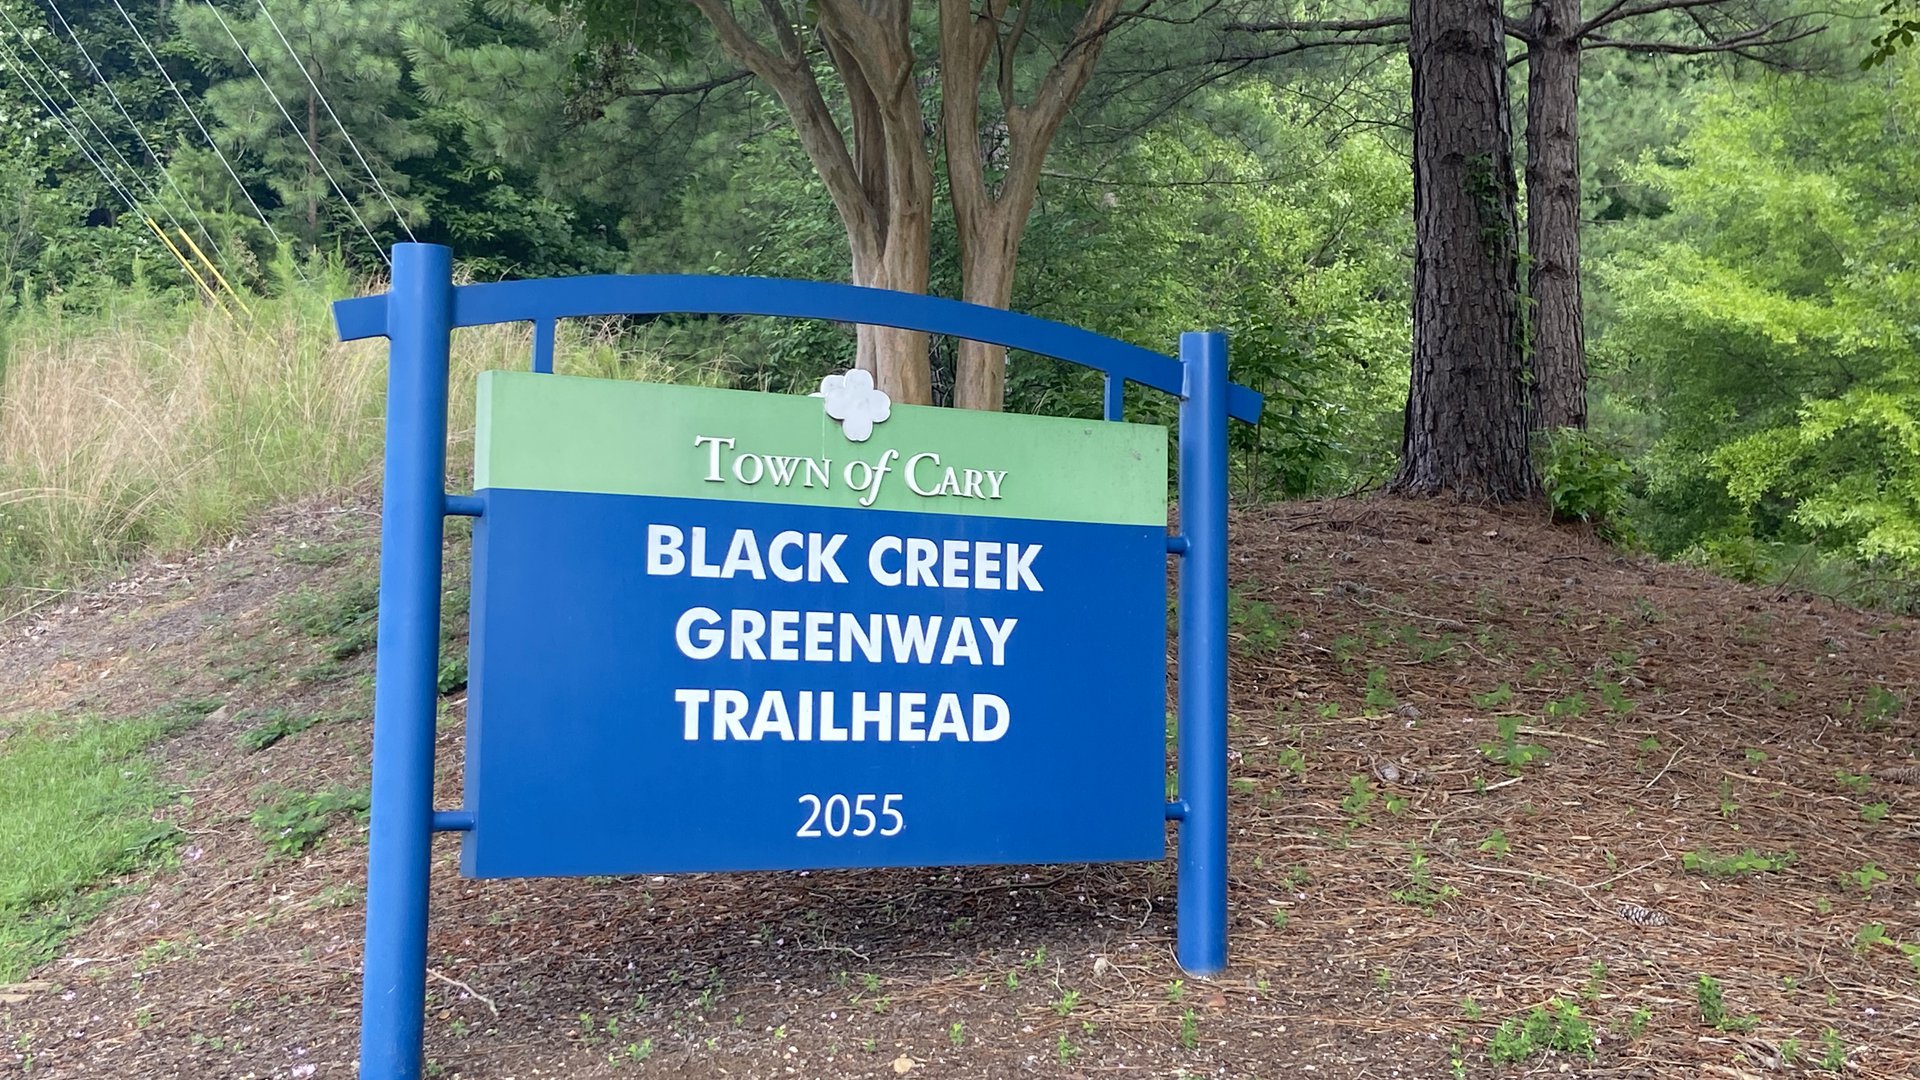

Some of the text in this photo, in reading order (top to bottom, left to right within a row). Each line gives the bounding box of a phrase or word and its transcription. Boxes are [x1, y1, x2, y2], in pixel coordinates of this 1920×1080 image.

[843, 449, 899, 506] of
[647, 525, 1043, 591] BLACK CREEK
[676, 607, 1017, 665] GREENWAY
[675, 689, 1009, 741] TRAILHEAD
[797, 794, 903, 837] 2055
